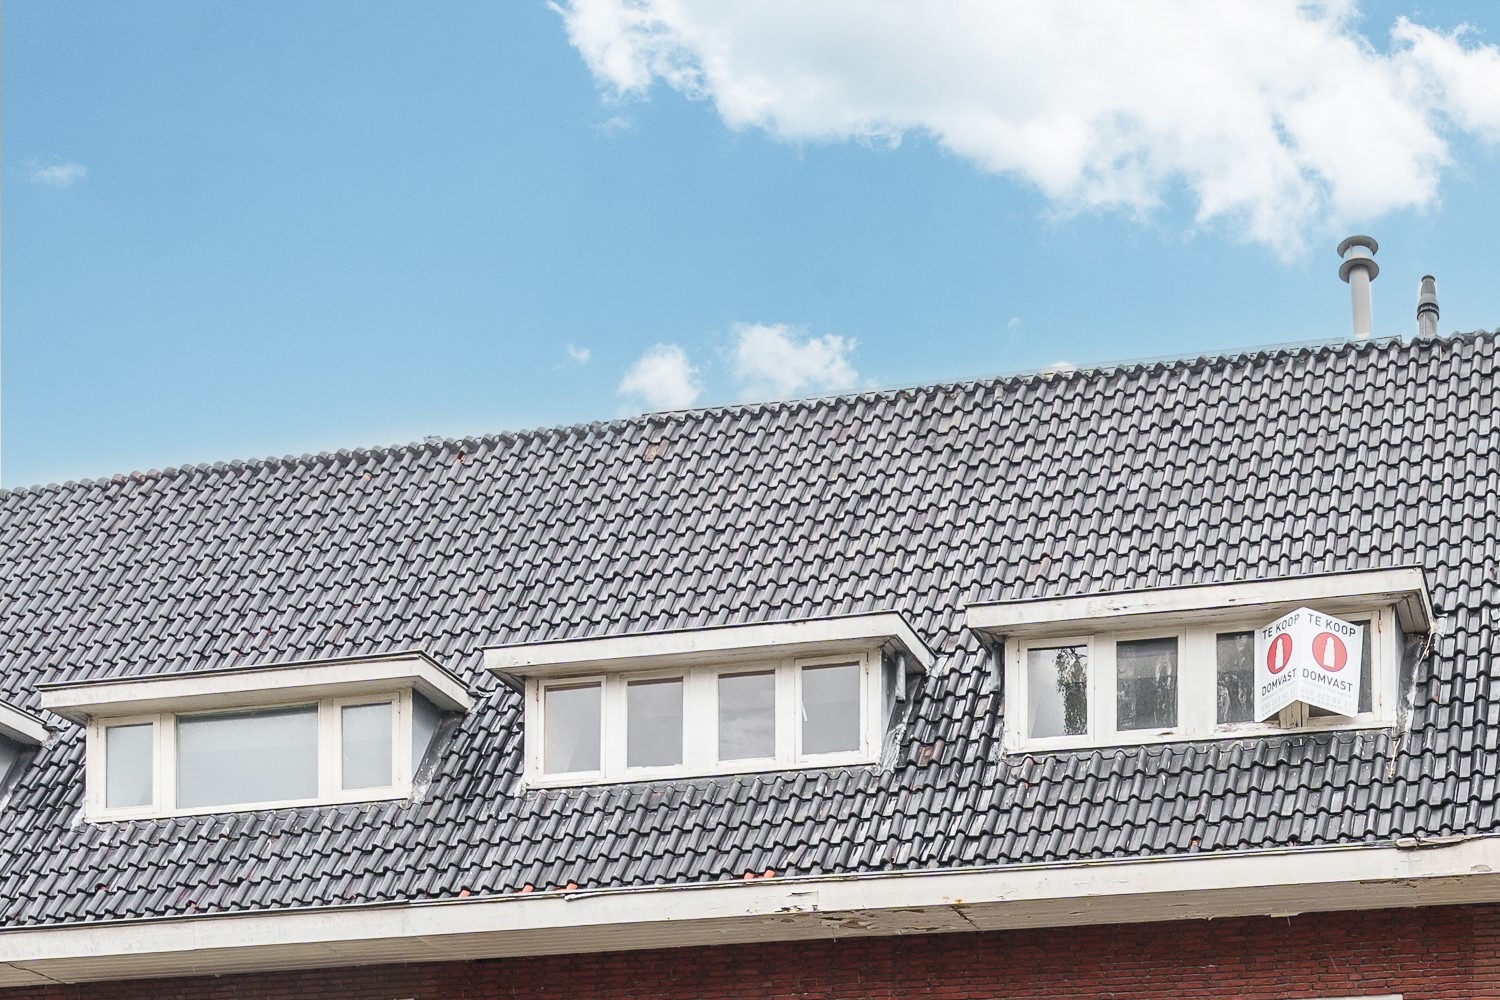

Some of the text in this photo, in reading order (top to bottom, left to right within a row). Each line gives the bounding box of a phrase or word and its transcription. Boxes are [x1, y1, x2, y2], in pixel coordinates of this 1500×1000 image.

[1262, 613, 1300, 640] TE KOOP
[1307, 613, 1356, 637] TE KOOP
[1261, 668, 1297, 696] DOMVAST
[1302, 668, 1353, 693] DOMVAST
